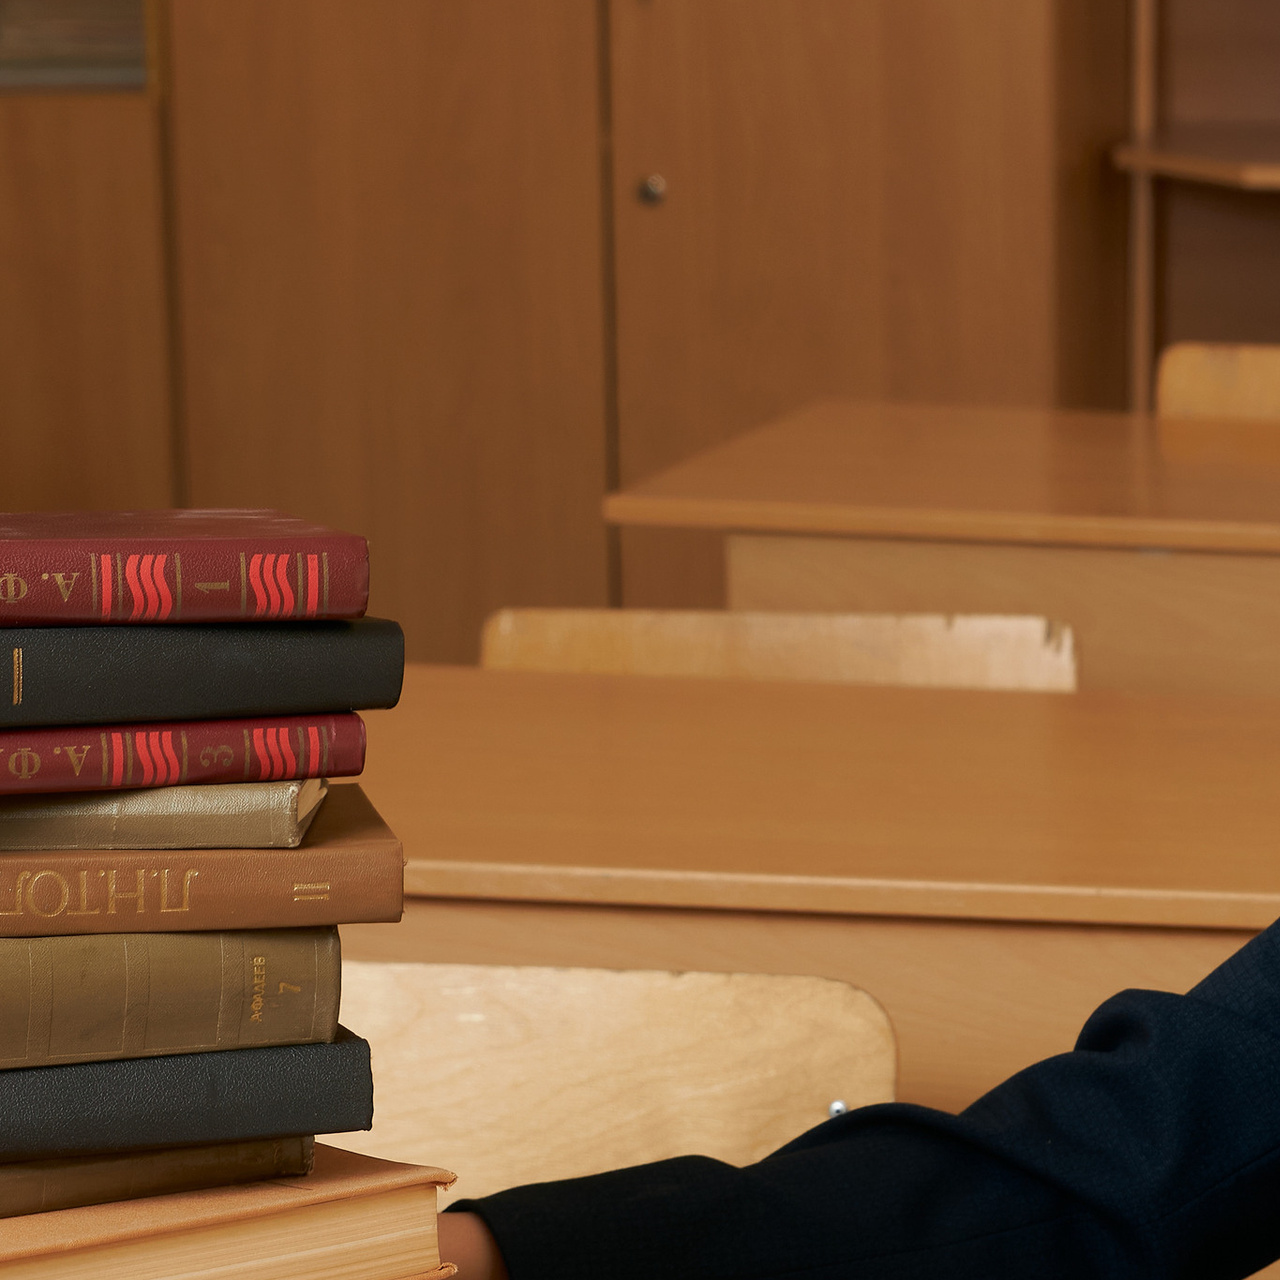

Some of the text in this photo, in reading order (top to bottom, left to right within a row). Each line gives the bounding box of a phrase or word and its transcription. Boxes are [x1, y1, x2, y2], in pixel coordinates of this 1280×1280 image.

[194, 579, 231, 594] 1
[200, 744, 235, 768] 3
[278, 981, 302, 995] 7
